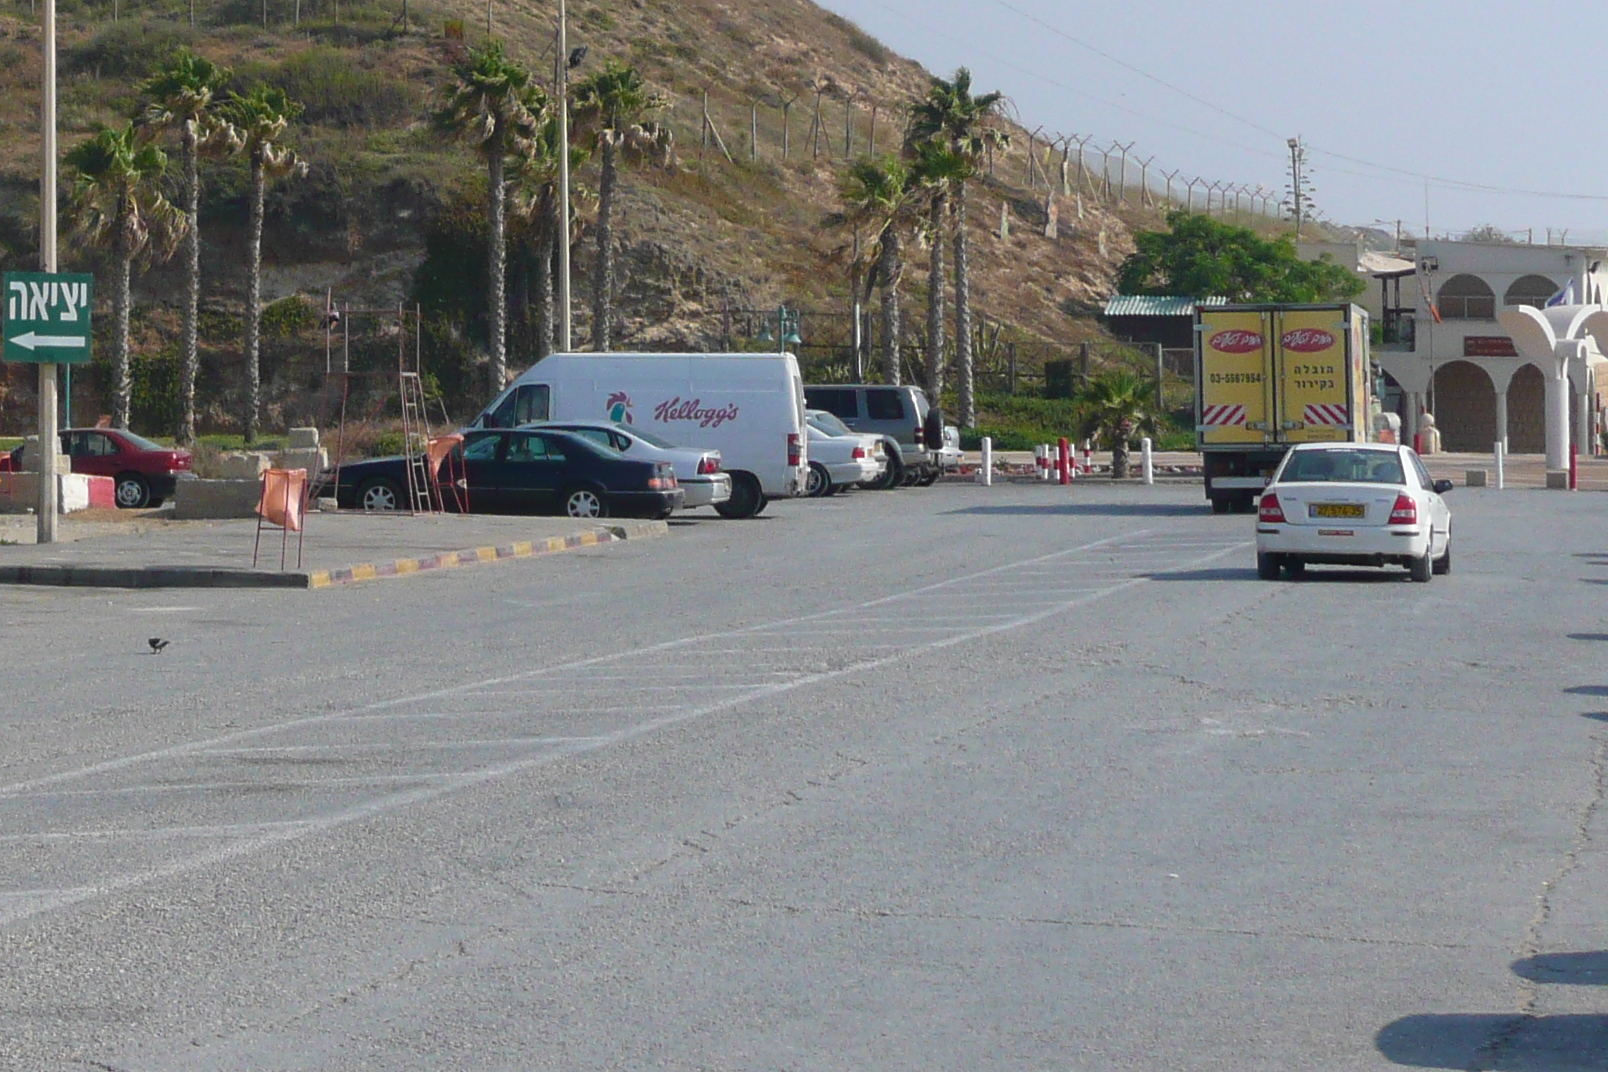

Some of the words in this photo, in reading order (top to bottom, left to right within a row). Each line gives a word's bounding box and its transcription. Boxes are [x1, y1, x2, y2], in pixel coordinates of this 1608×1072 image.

[9, 281, 87, 321] יציאה
[1294, 380, 1334, 391] בקירור
[654, 396, 739, 428] Kellogg's
